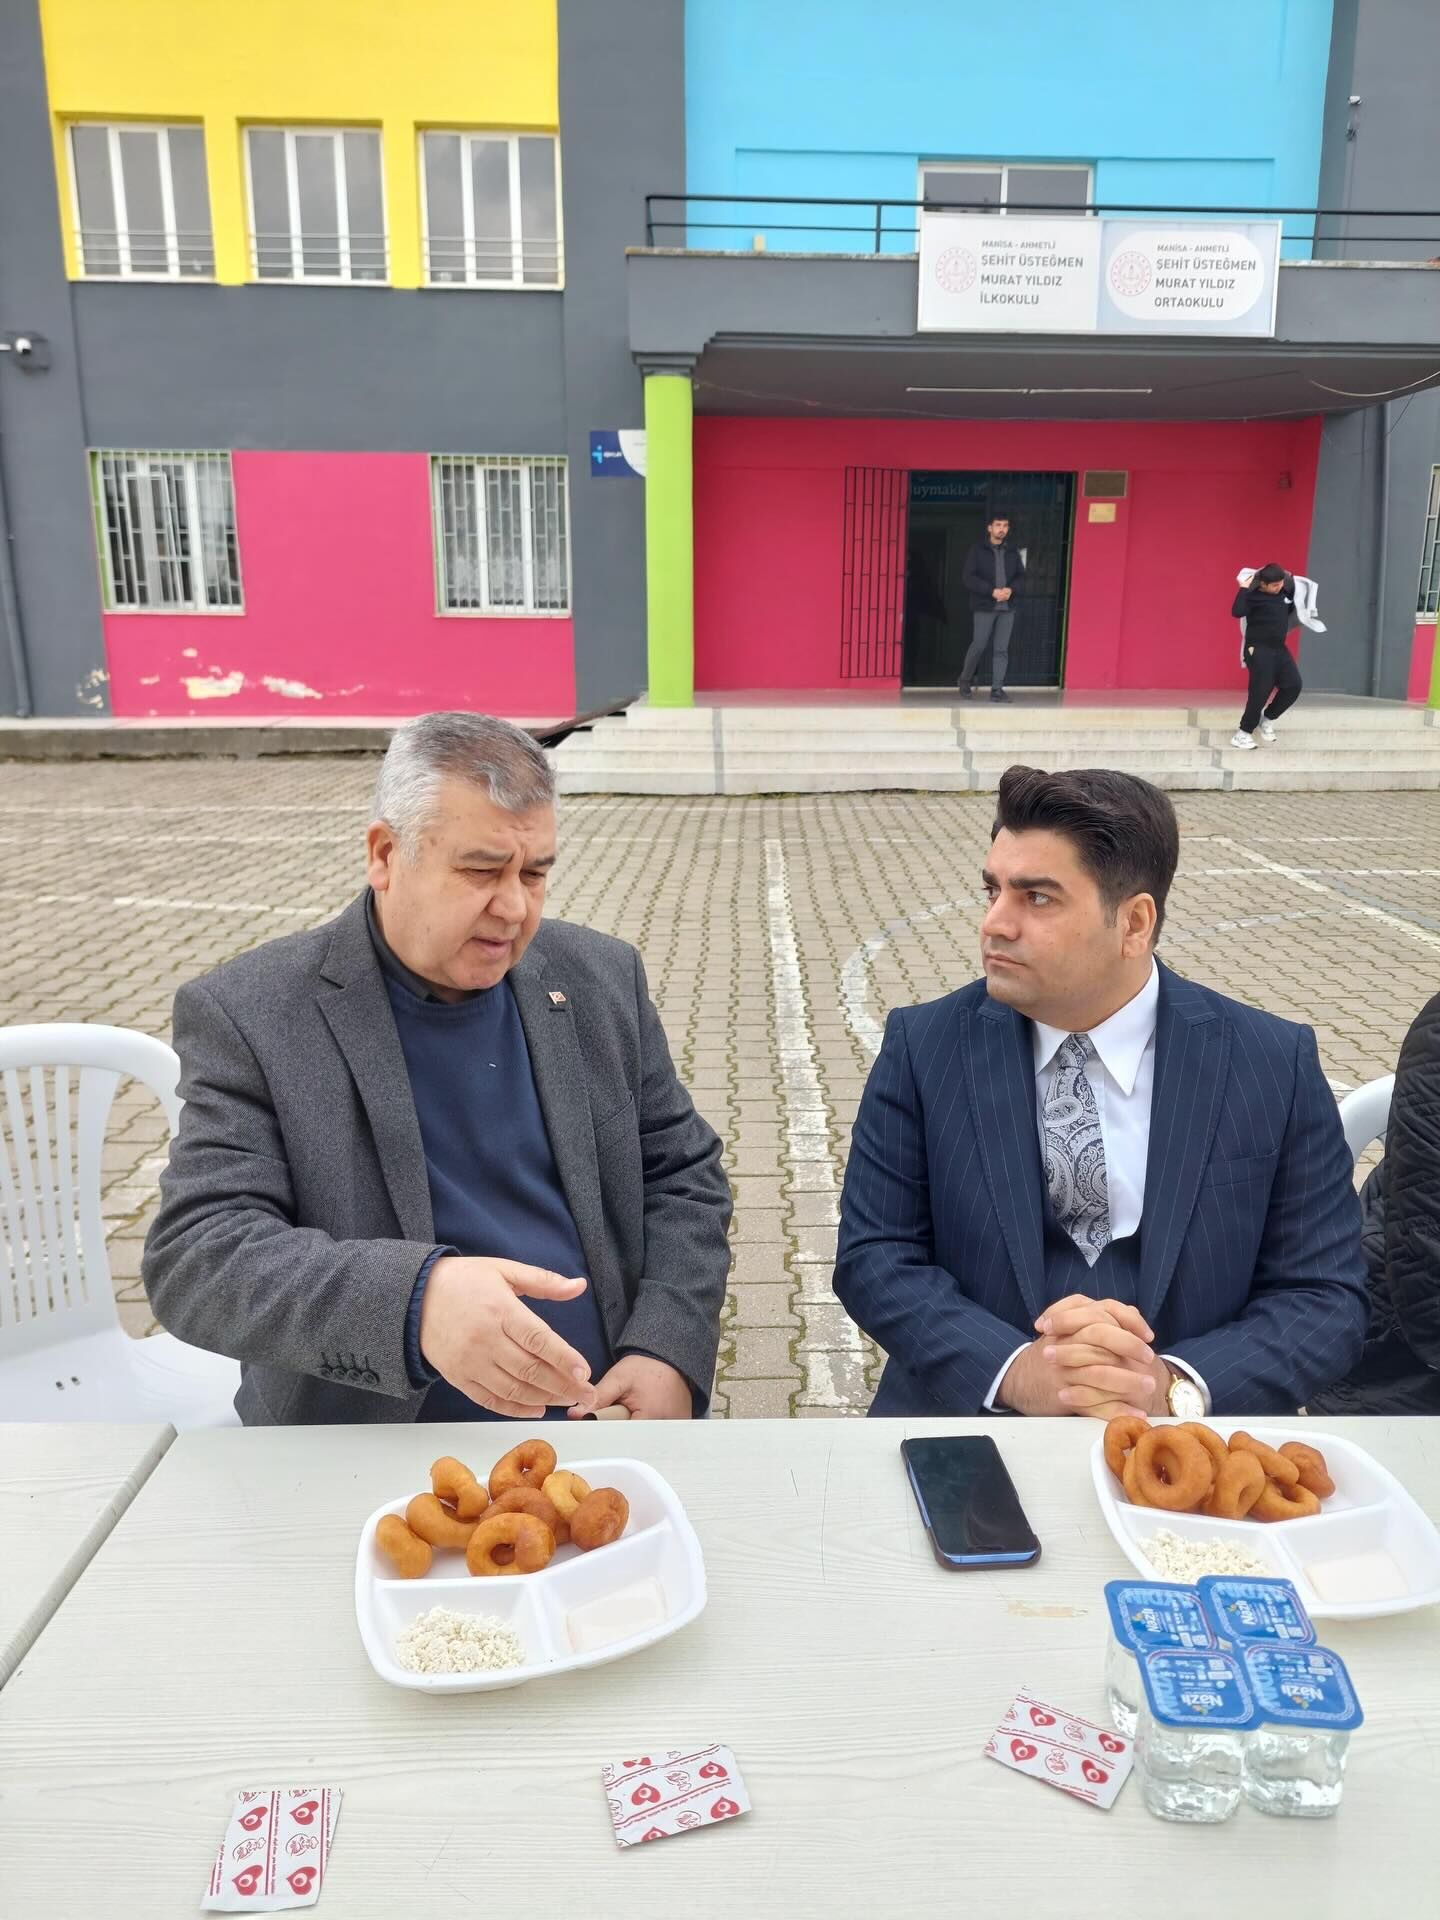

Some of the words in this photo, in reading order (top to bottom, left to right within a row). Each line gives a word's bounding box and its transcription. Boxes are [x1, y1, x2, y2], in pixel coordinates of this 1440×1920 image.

[1020, 241, 1056, 250] AHMETLİ
[1194, 245, 1229, 253] AHMETLİ
[981, 253, 1016, 267] ŞEHİT
[1018, 253, 1083, 268] ÜSTEĞMEN
[1156, 257, 1190, 271] ŞEHİT
[1193, 257, 1256, 271] ÜSTEĞMEN
[981, 274, 1022, 285] MURAT
[1025, 275, 1062, 287] YILDIZ
[1155, 278, 1196, 289] MURAT
[1199, 279, 1235, 289] YILDIZ
[980, 291, 1039, 305] İLKOKULU
[1154, 297, 1224, 308] ORTAOKULU
